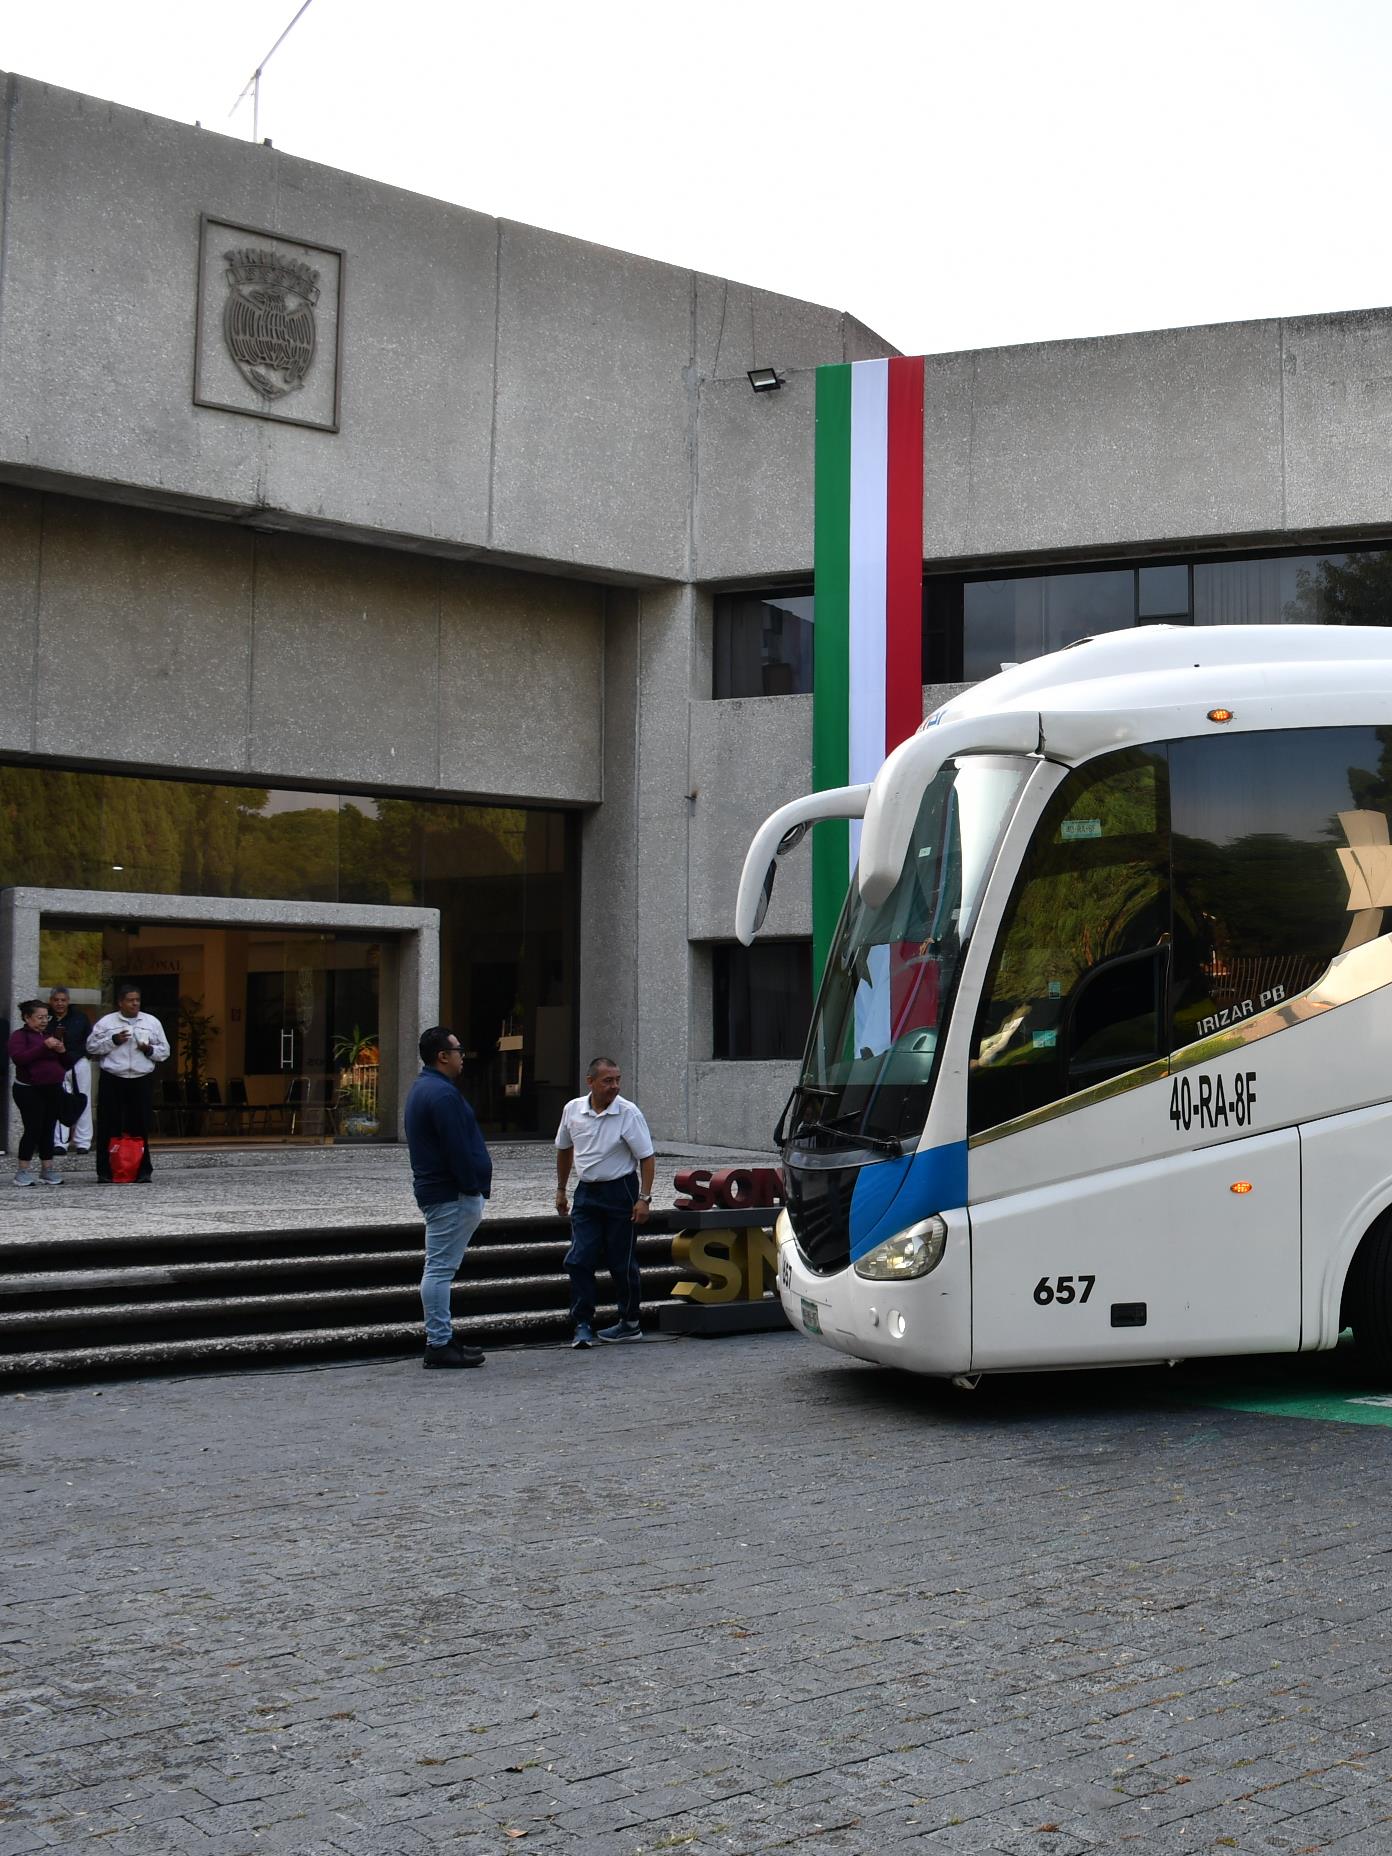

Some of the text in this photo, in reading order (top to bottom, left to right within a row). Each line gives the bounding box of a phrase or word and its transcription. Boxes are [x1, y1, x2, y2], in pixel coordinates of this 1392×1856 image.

[1196, 985, 1285, 1035] IRIZAR PB
[1169, 1071, 1256, 1131] 40-RA-8F
[1033, 1275, 1095, 1305] 657
